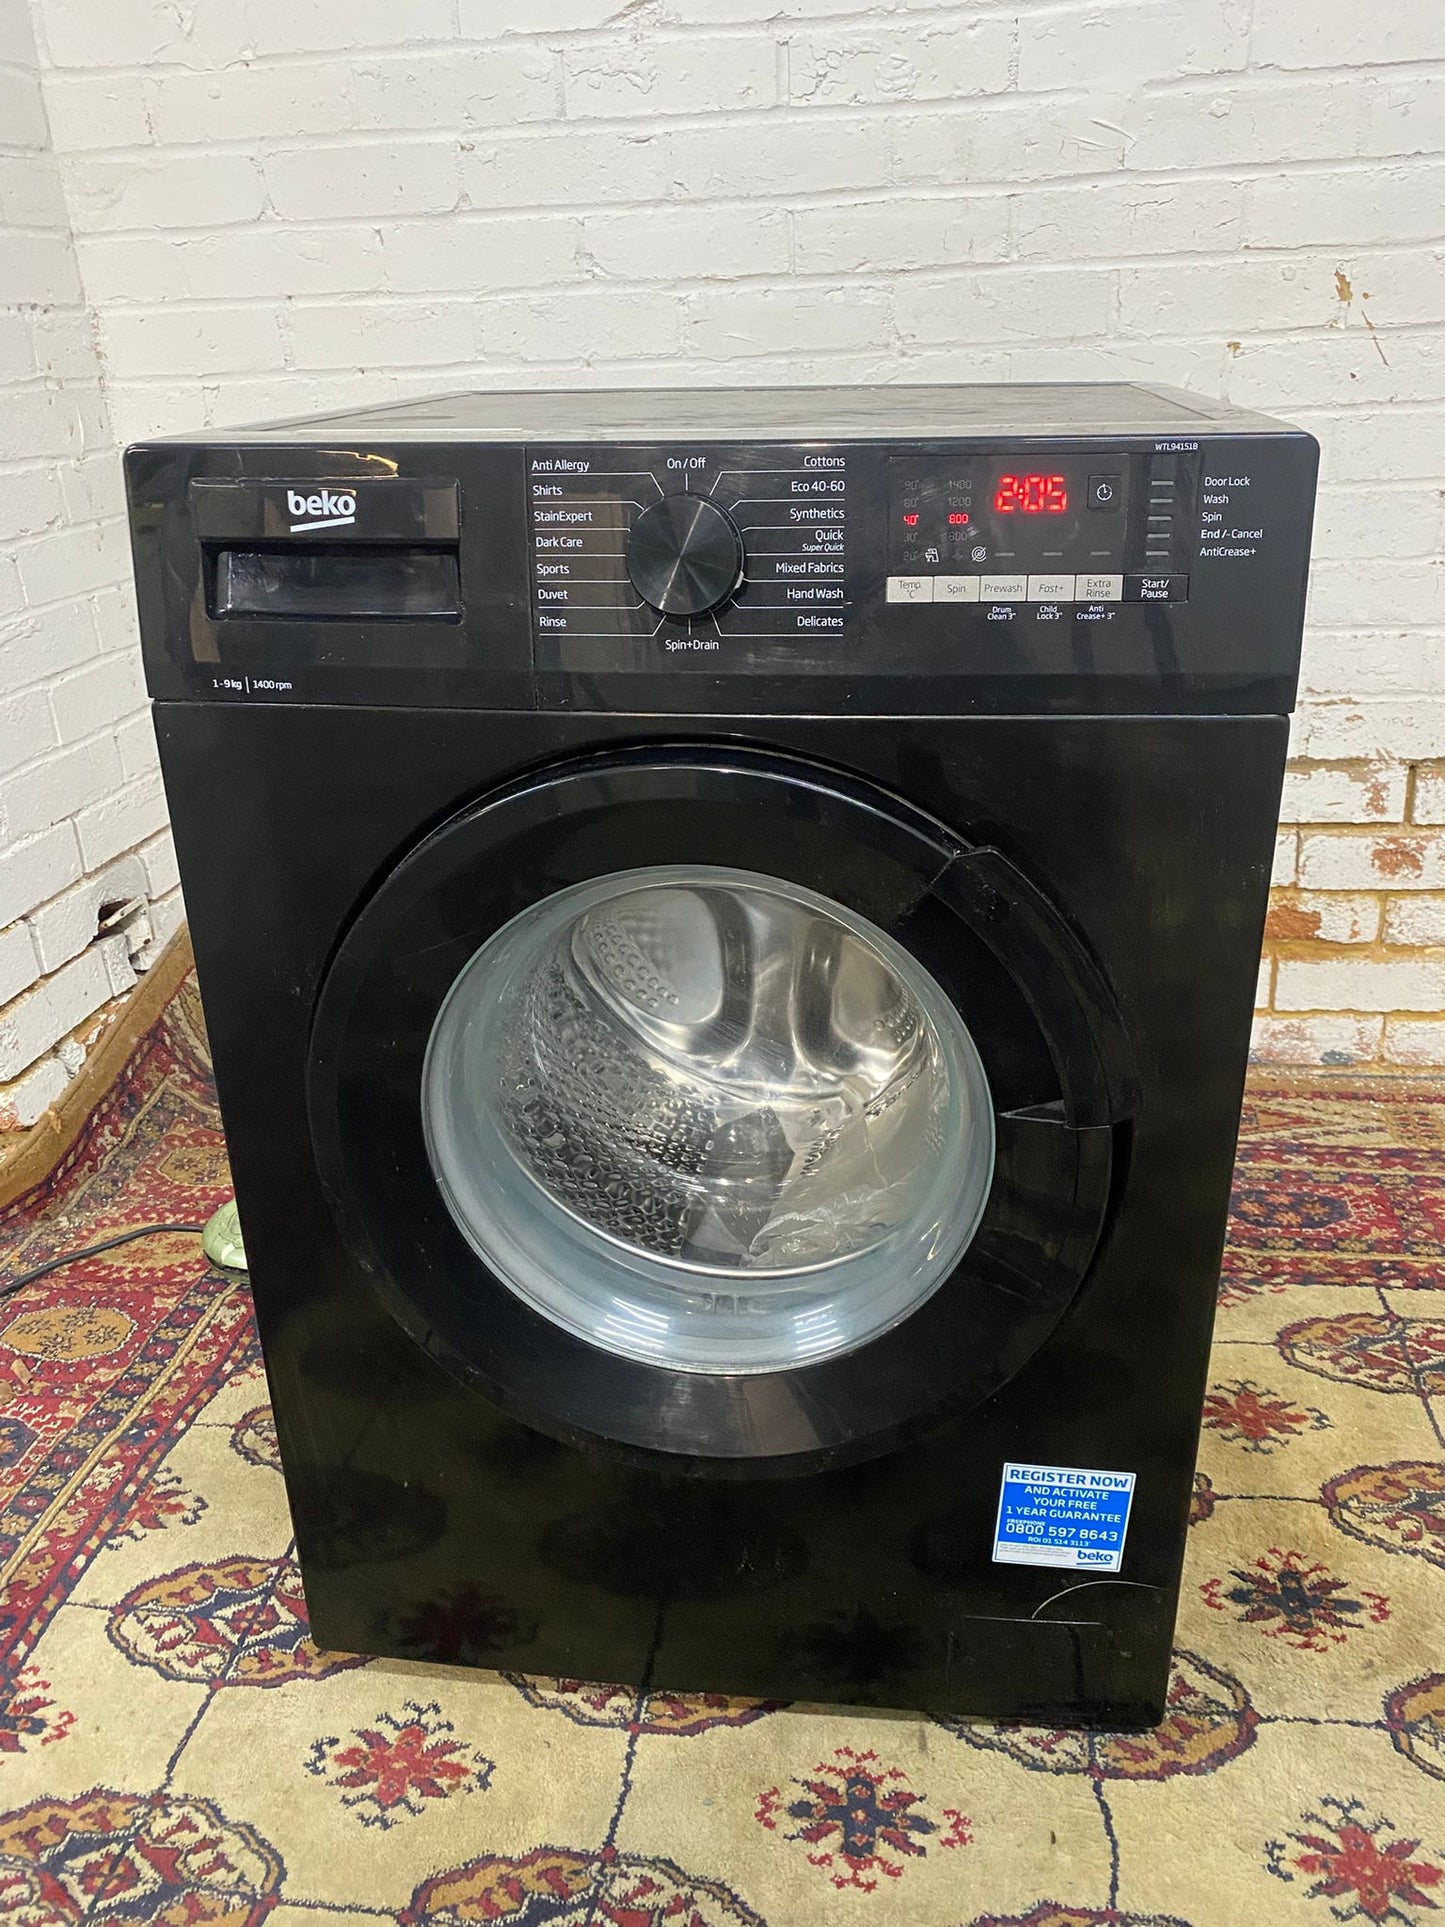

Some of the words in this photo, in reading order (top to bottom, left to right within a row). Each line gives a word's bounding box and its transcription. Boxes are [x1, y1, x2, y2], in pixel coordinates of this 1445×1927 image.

[1155, 442, 1198, 450] WTL94151B
[532, 460, 552, 470] Anti
[554, 460, 590, 472] Allergy
[667, 458, 682, 469] On
[690, 458, 706, 468] Off
[804, 456, 846, 467] Cottons
[792, 482, 810, 492] Eco
[811, 480, 846, 492] 40-60
[948, 480, 972, 490] 1400
[1204, 476, 1227, 486] Door
[1228, 476, 1250, 486] Lock
[532, 485, 562, 496] Shirts
[996, 475, 1068, 511] 2:05
[288, 490, 356, 516] beko
[948, 497, 972, 506] 1200
[1203, 494, 1229, 504] Wash
[534, 510, 592, 524] StainExpert
[790, 508, 845, 522] Synthetics
[948, 514, 969, 524] 800
[1202, 512, 1222, 523] Spin
[815, 530, 844, 542] Quick
[1200, 528, 1220, 538] End
[1231, 528, 1263, 538] Cancel
[536, 536, 558, 548] Dark
[560, 537, 584, 548] Care
[802, 544, 824, 552] Super
[824, 542, 844, 552] Quick
[1200, 547, 1256, 556] AntiCrease+
[536, 564, 570, 576] Sports
[776, 562, 806, 573] Mixed
[808, 562, 844, 573] Fabrics
[946, 584, 966, 594] Spin
[984, 584, 1023, 593] Prewash
[1038, 584, 1064, 593] Fast+
[1086, 579, 1112, 588] Extra
[1142, 579, 1170, 589] Start/
[538, 589, 568, 600] Duvet
[786, 588, 814, 599] Hand
[816, 588, 844, 599] Wash
[1086, 588, 1110, 598] Rinse
[1140, 589, 1169, 598] Pause
[539, 616, 567, 627] Rinse
[797, 616, 844, 627] Delicates
[1076, 612, 1105, 620] Crease+
[665, 640, 720, 652] Spin+Drain
[1010, 1469, 1086, 1485] REGISTER
[1090, 1476, 1128, 1488] NOW
[1024, 1486, 1050, 1496] AND
[1052, 1487, 1110, 1500] ACTIVATE
[1034, 1497, 1066, 1508] YOUR
[1068, 1500, 1098, 1510] FREE
[1006, 1506, 1013, 1514] 1
[1016, 1506, 1047, 1517] YEAR
[1050, 1509, 1122, 1524] GUARANTEE
[1006, 1518, 1046, 1526] FREEPHONE
[1005, 1523, 1044, 1536] 0800
[1048, 1526, 1076, 1538] 597
[1079, 1529, 1118, 1542] 8643
[1077, 1550, 1114, 1562] beko
